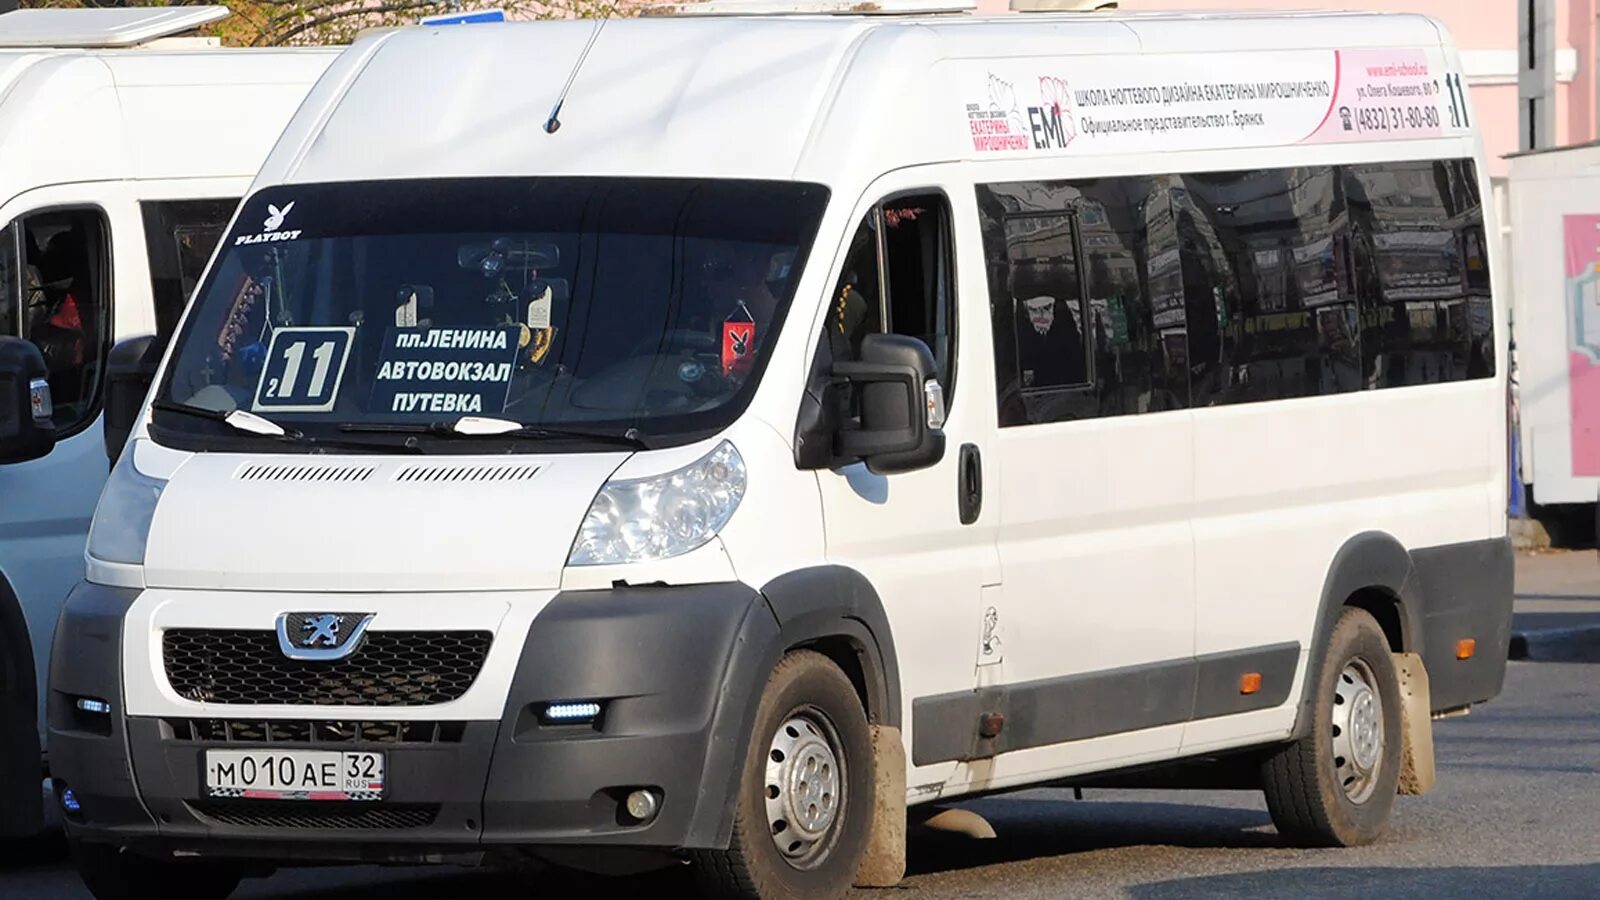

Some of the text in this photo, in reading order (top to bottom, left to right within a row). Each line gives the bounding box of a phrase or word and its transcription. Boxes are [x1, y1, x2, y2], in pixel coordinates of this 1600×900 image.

[1074, 80, 1330, 107] ШКОЛА НОГТЕВОГО ДИЗАЙНА ЕКАТЕРИНЫ МИРОШНИЧЕНКО
[1445, 73, 1470, 128] 11
[1081, 116, 1142, 138] Официальное
[1143, 114, 1225, 135] представительство
[1232, 109, 1264, 131] Брянск
[1354, 105, 1440, 134] (4832) 31-80-80
[234, 230, 303, 246] PLAYBOY
[277, 341, 336, 398] 11
[377, 361, 512, 383] АВТОВОКЗАЛ
[266, 378, 278, 398] 2
[392, 392, 482, 413] ПУТЕВКА
[347, 755, 376, 779] 32
[345, 779, 368, 789] RUS
